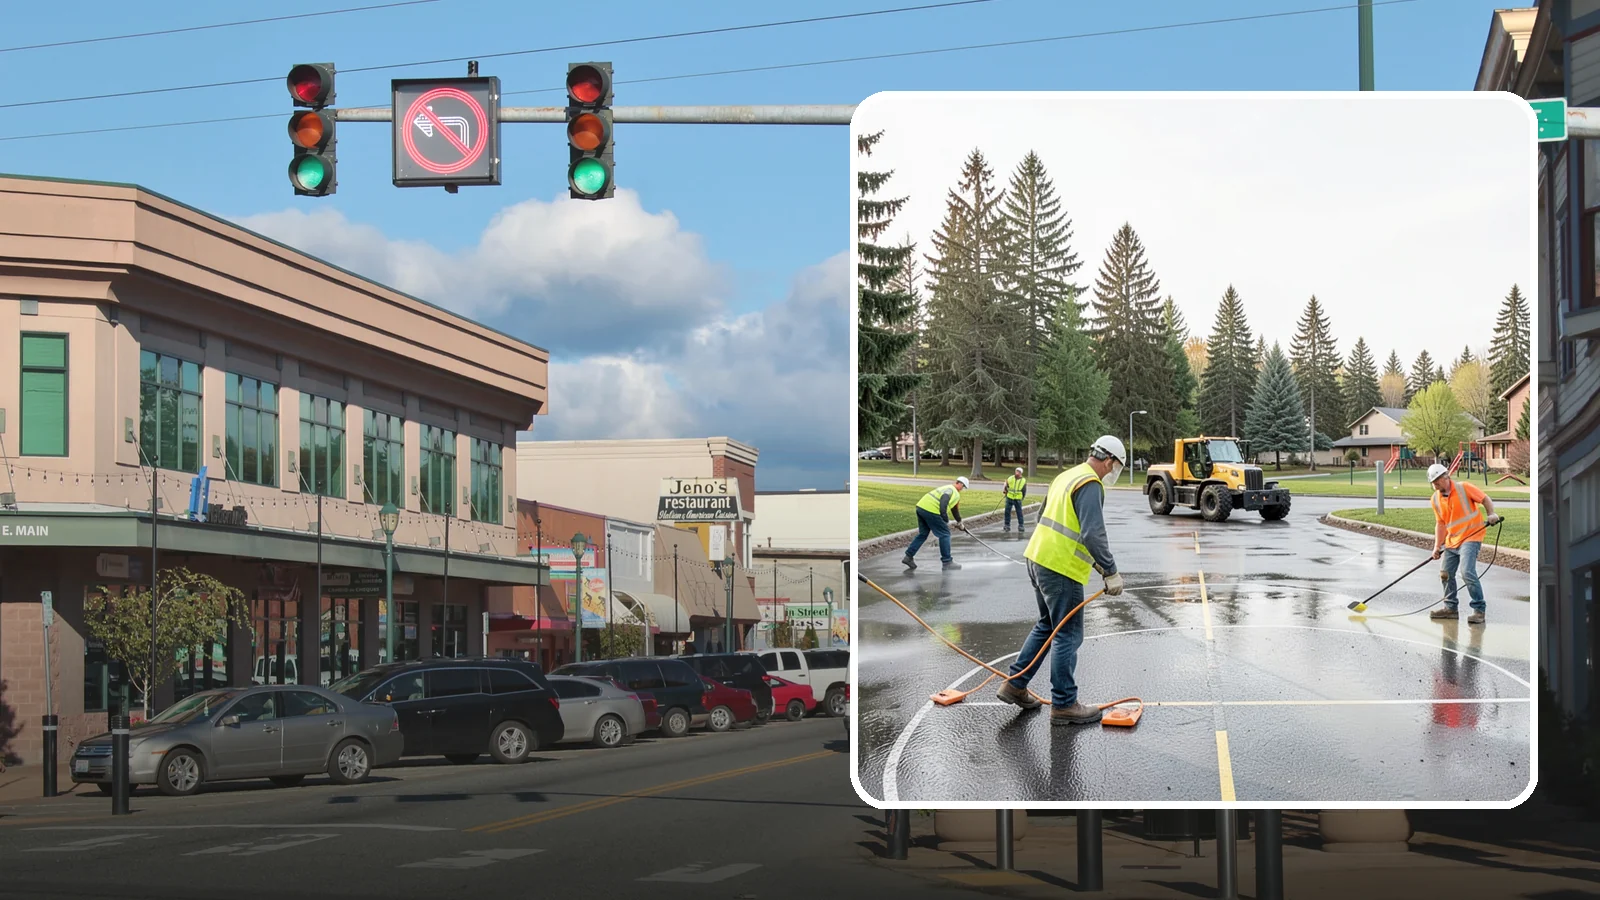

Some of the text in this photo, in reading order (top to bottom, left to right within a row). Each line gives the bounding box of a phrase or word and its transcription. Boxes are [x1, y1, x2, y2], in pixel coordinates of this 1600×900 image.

[670, 480, 727, 494] Jeno's
[665, 496, 731, 509] restaurant
[658, 510, 681, 519] Italian
[686, 510, 714, 519] American
[715, 509, 737, 519] Cuisine
[2, 525, 49, 536] E. MAIN
[797, 608, 828, 616] Street
